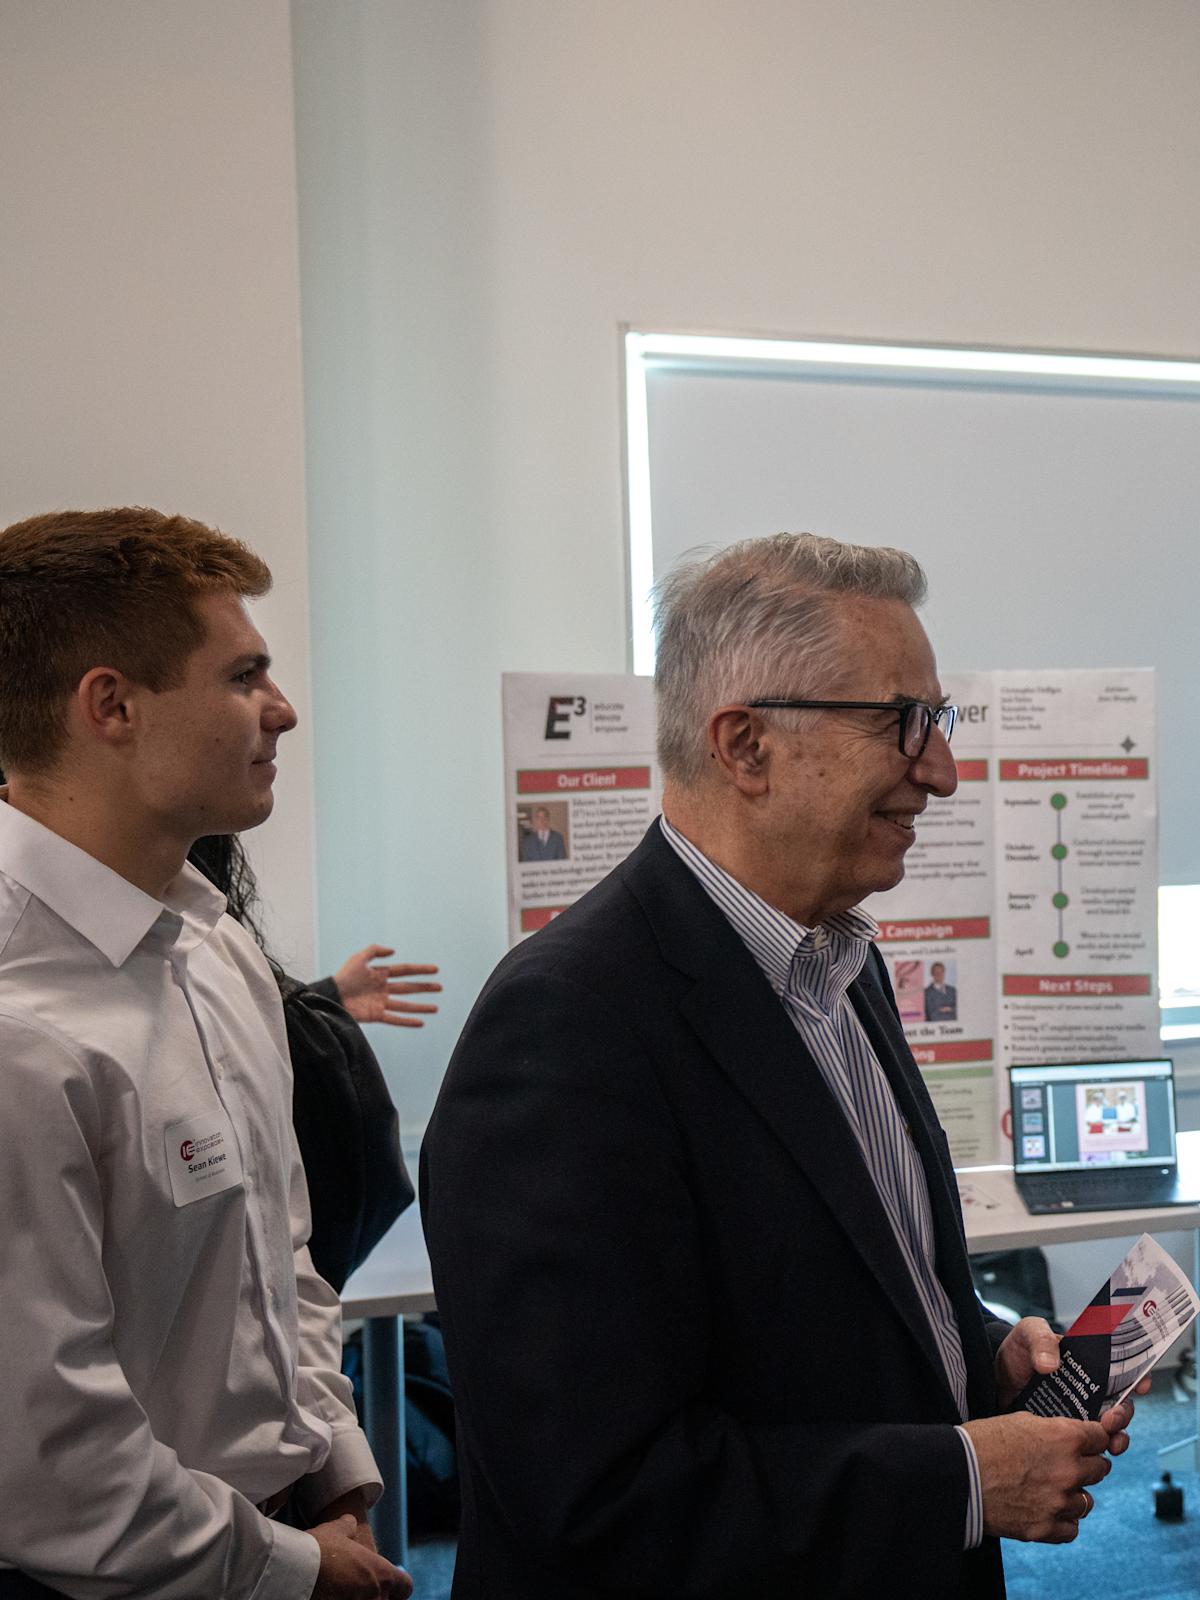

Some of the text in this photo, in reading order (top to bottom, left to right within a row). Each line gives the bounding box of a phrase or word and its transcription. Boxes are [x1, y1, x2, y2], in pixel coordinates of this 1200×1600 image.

[1018, 763, 1128, 778] Project Timeline
[558, 772, 616, 788] Our Client
[886, 924, 954, 939] Campaign
[1040, 979, 1114, 994] Next Steps
[920, 1028, 935, 1036] the
[938, 1026, 964, 1035] Team
[188, 1161, 207, 1174] Sean
[1062, 1350, 1091, 1384] Factors
[1090, 1382, 1100, 1394] of
[1060, 1360, 1090, 1400] Executive
